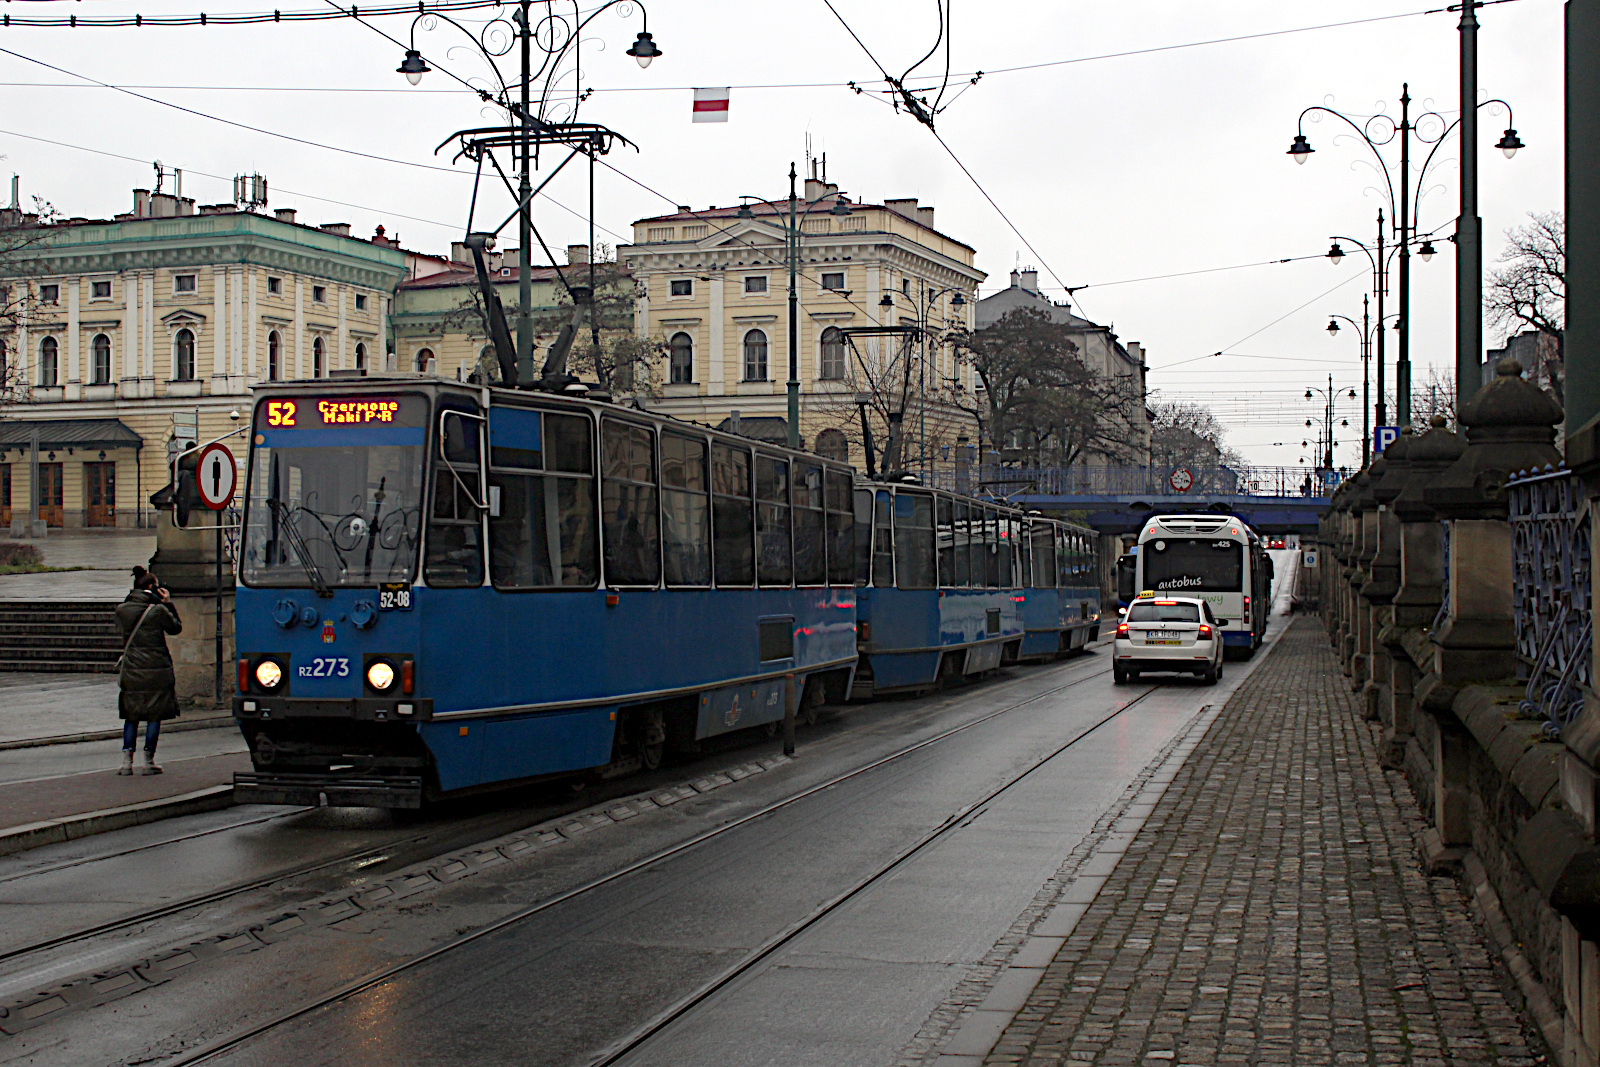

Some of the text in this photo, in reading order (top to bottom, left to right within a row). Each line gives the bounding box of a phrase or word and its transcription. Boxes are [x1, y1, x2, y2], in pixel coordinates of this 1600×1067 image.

[268, 402, 296, 426] 52
[318, 401, 398, 412] Czerwone
[323, 410, 393, 423] Maki P+R
[1380, 429, 1396, 451] P
[1250, 482, 1258, 491] 10
[1158, 575, 1202, 590] autobus
[380, 591, 410, 608] 52-08
